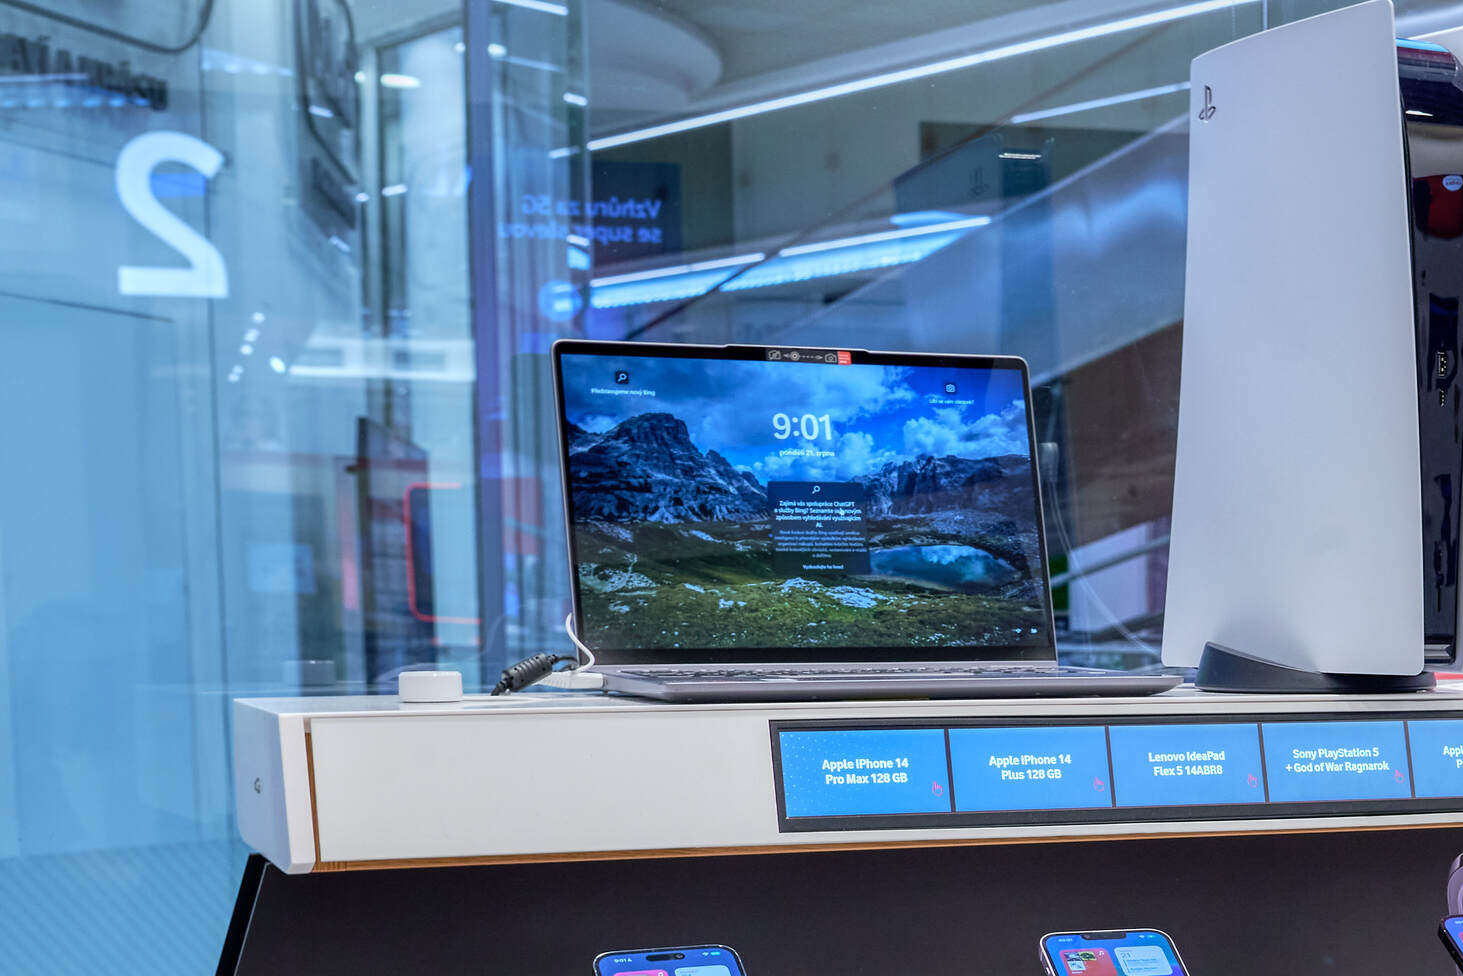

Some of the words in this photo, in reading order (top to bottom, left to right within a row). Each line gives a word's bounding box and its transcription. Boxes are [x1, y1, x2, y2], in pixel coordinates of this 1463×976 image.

[773, 413, 832, 440] 9:01
[1149, 752, 1186, 762] Lenovo
[1186, 751, 1225, 761] IdeaPad
[1292, 749, 1317, 760] Sony
[1318, 748, 1371, 760] PlayStation
[1372, 747, 1379, 757] 5
[822, 759, 854, 772] Apple
[856, 758, 893, 769] iPhone
[895, 758, 909, 768] 14
[989, 755, 1019, 768] Apple
[1021, 754, 1057, 765] iPhone
[1058, 754, 1072, 764] 14
[1285, 764, 1292, 772] +
[1293, 762, 1313, 772] God
[1314, 762, 1324, 772] of
[1324, 762, 1343, 772] War
[1344, 761, 1390, 773] Ragnarok
[1001, 769, 1024, 780] Plus
[1026, 769, 1046, 779] 128
[1047, 768, 1062, 779] GB
[1153, 766, 1175, 776] Flex
[1176, 765, 1183, 775] 5
[1184, 765, 1223, 775] 14ABR8
[825, 774, 844, 784] Pro
[847, 773, 869, 784] Max
[871, 773, 891, 783] 128
[892, 772, 908, 783] GB
